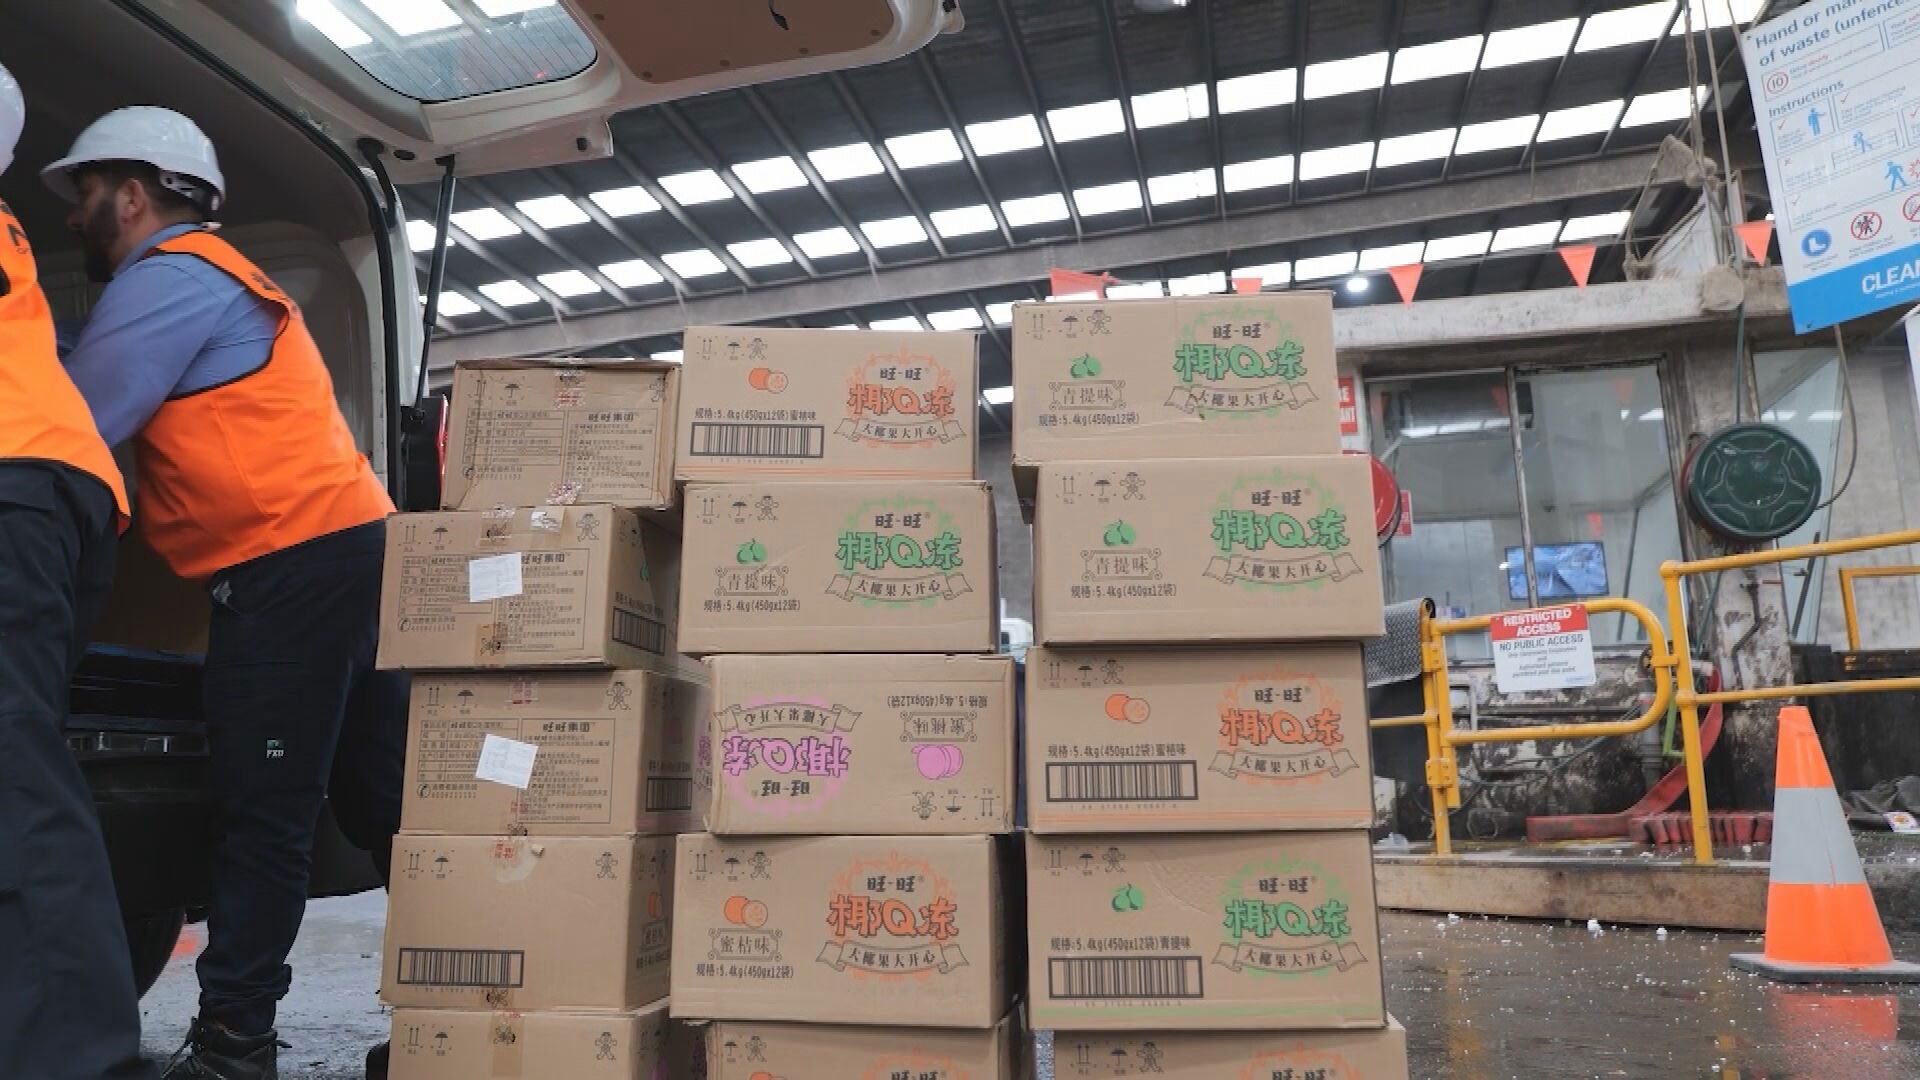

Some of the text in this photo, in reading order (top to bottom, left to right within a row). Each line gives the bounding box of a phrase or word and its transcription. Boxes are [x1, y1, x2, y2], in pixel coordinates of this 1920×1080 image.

[1756, 20, 1798, 48] Hand
[1803, 11, 1821, 27] or
[1759, 50, 1776, 67] of
[1780, 28, 1830, 57] waste
[1768, 80, 1844, 117] Instructions
[1173, 341, 1307, 382] 椰Q冻
[847, 384, 955, 416] 椰Q冻
[1210, 508, 1350, 552] 椰Q冻
[835, 531, 963, 570] 椰Q冻
[1504, 608, 1572, 626] RESTRICTED
[1517, 622, 1560, 636] ACCESS
[1514, 638, 1545, 649] PUBLIC
[1548, 634, 1583, 645] ACCESS
[913, 717, 966, 735] 蜜桃味
[1219, 708, 1343, 746] 椰Q冻
[722, 736, 851, 777] 椰Q冻
[826, 894, 959, 939] 椰Q冻
[1222, 899, 1352, 938] 椰Q冻
